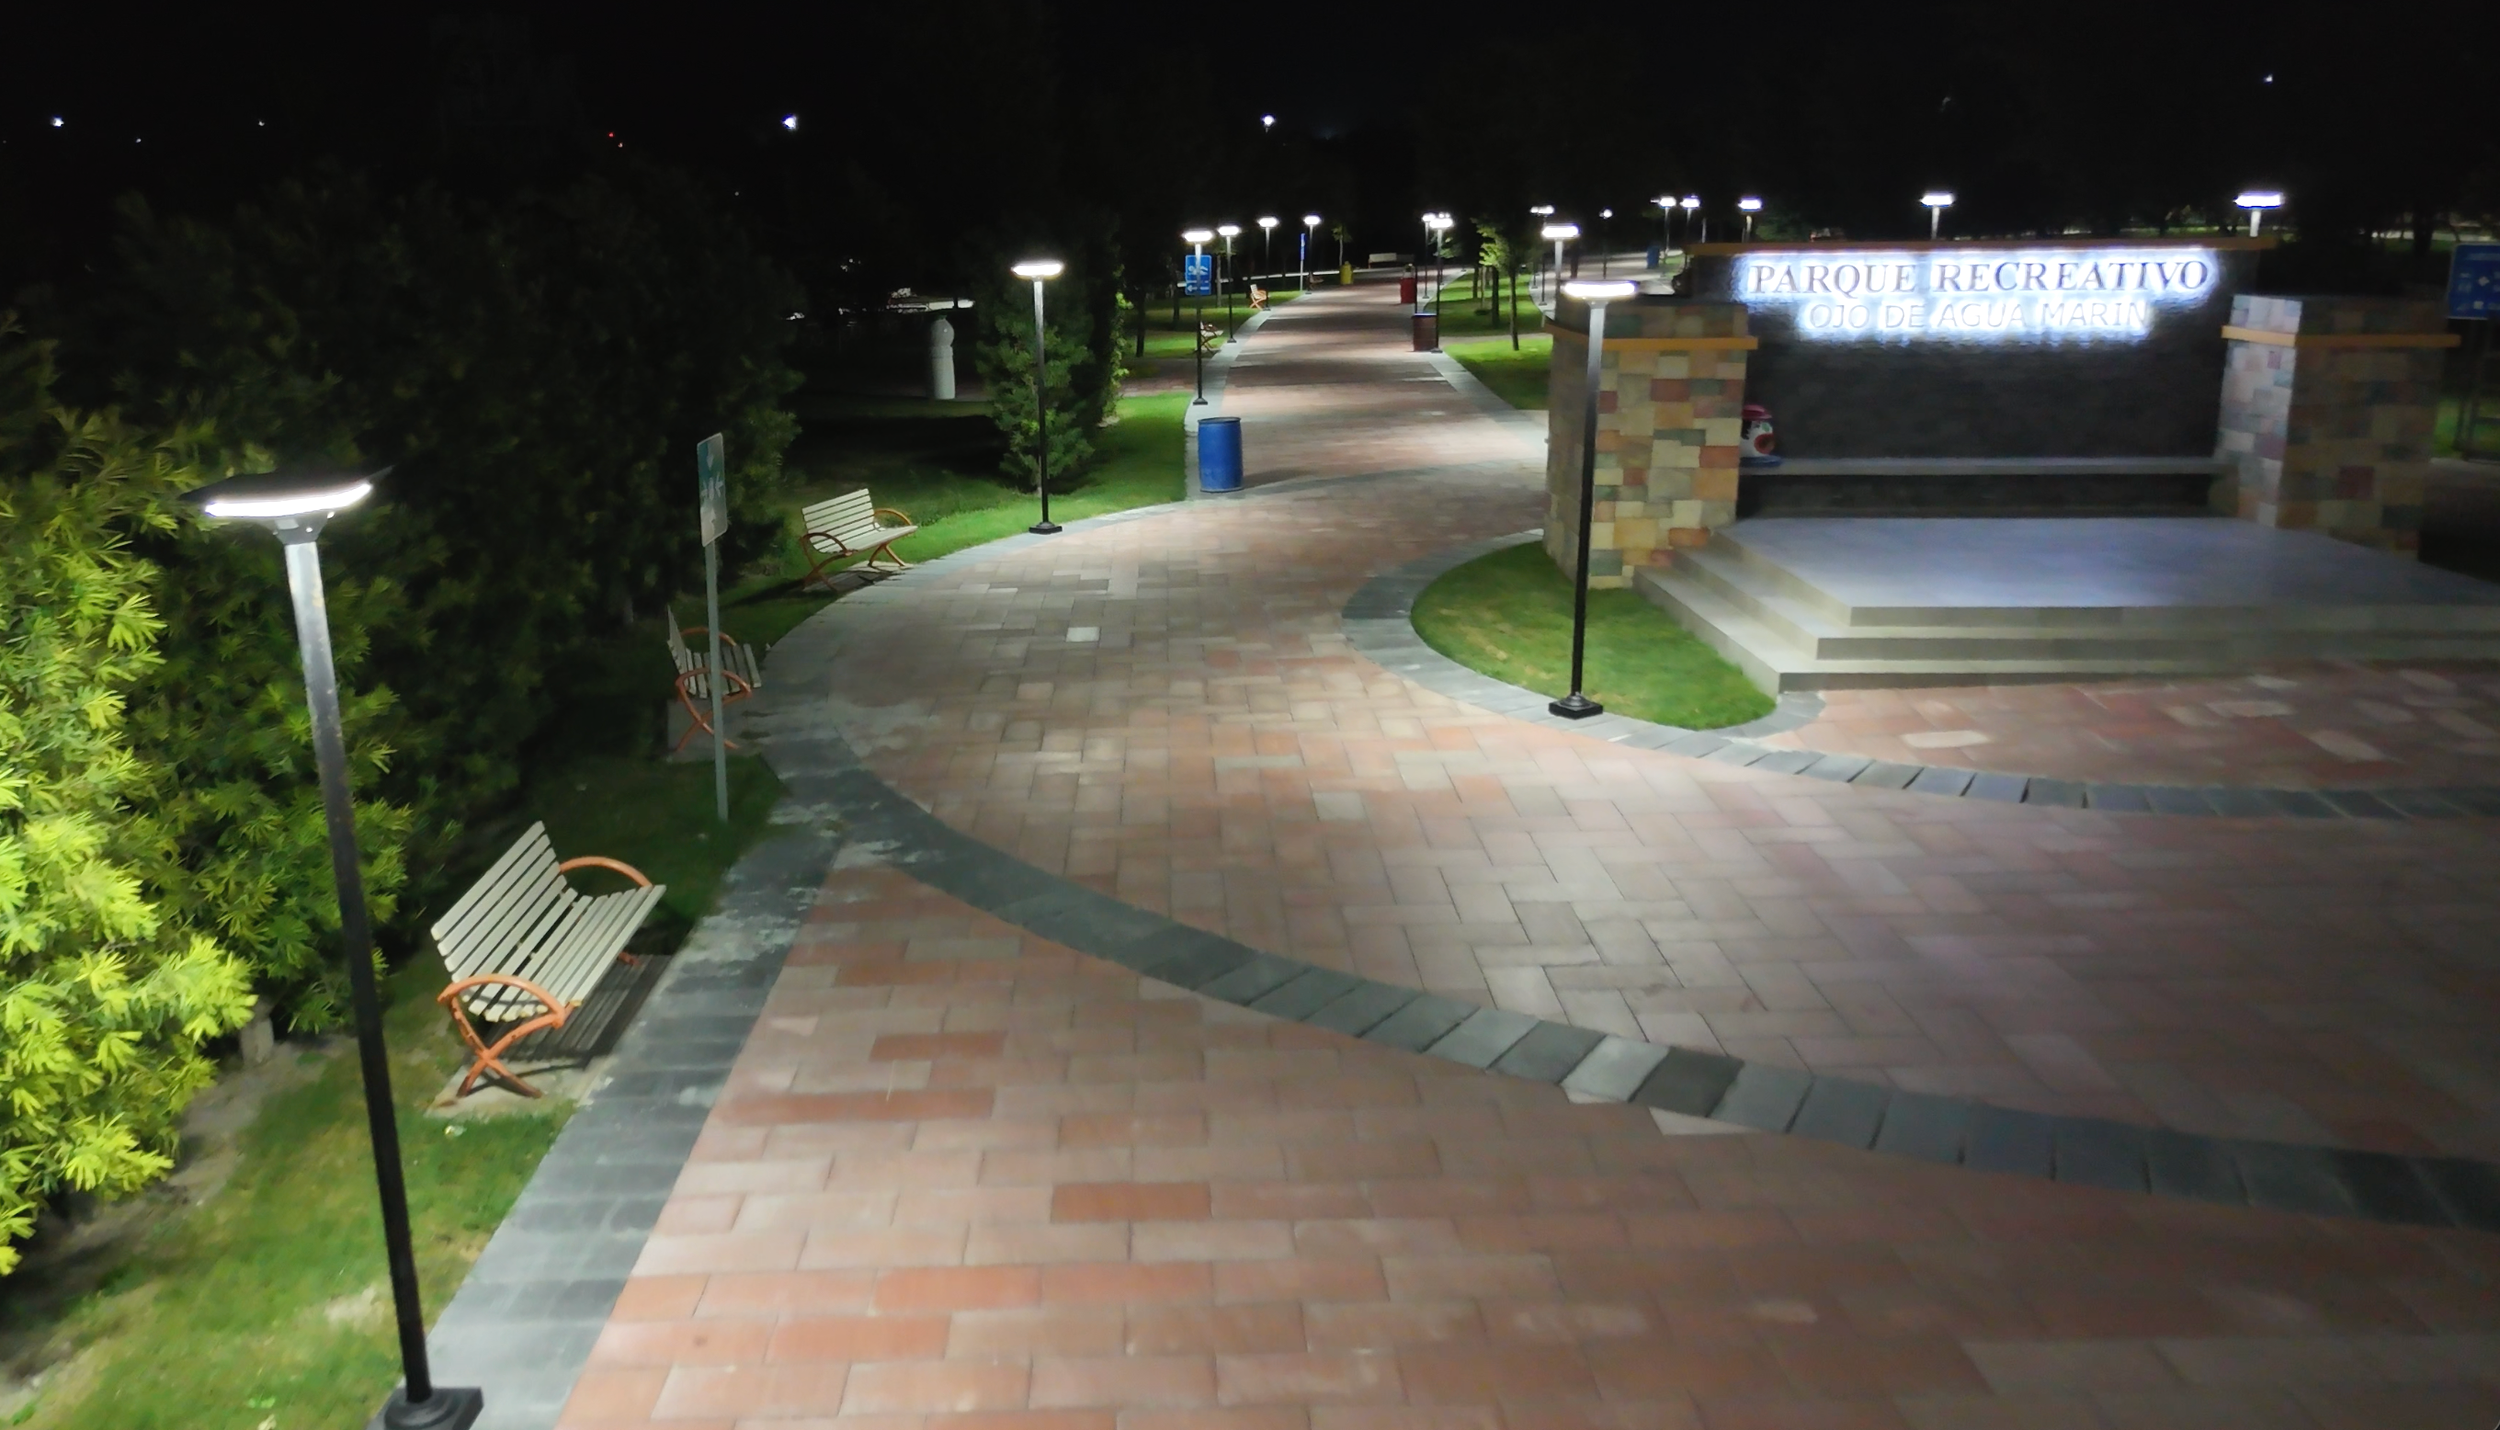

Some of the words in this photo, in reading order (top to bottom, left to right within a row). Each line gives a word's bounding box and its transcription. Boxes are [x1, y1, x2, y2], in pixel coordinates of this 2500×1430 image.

[1750, 264, 1916, 299] PARQUE
[1936, 261, 2208, 292] RECREATIVO
[1810, 303, 1870, 328] OJO
[1886, 303, 1926, 327] DE
[1937, 303, 2027, 328] AGUA
